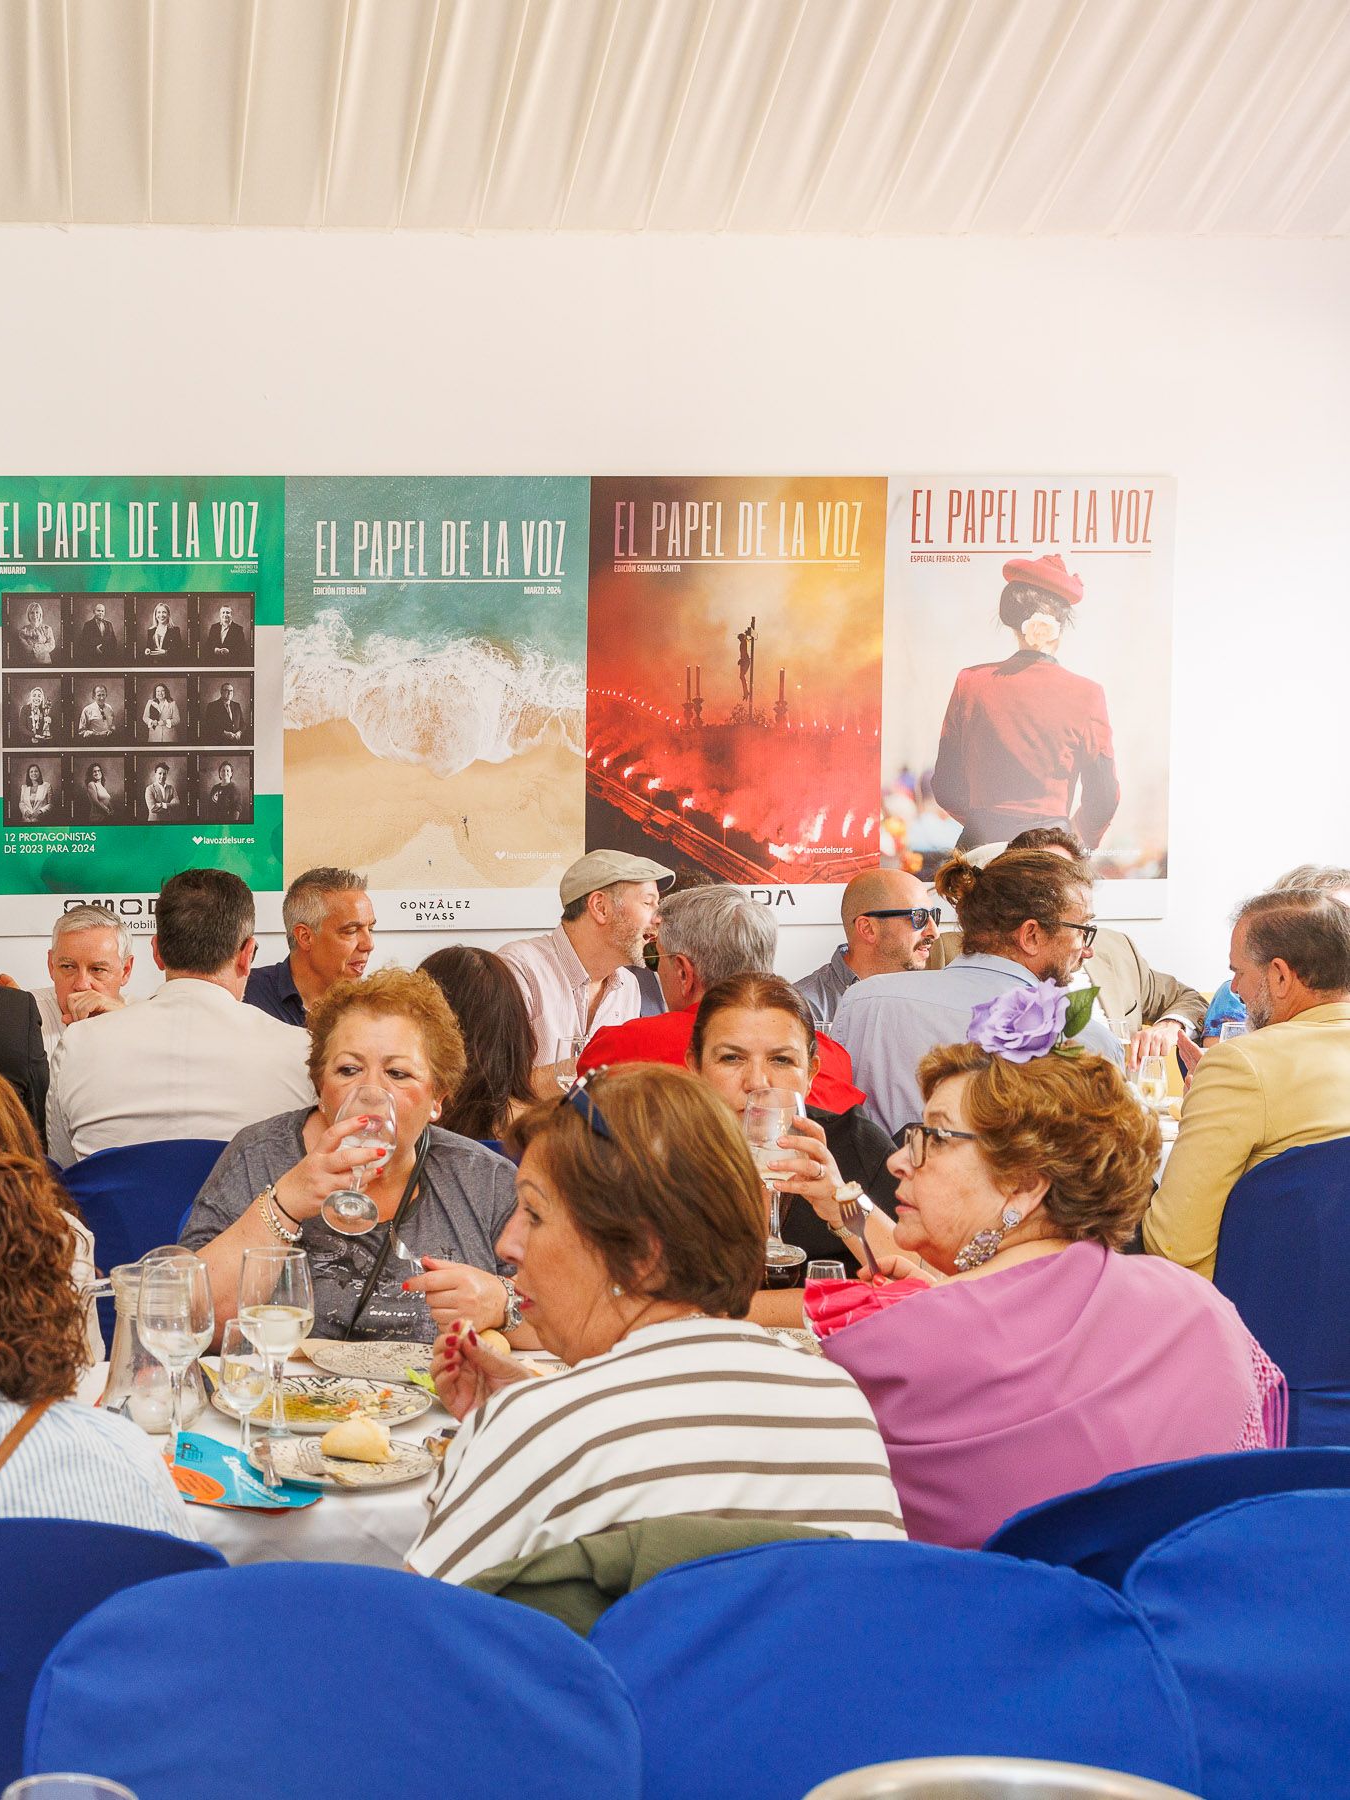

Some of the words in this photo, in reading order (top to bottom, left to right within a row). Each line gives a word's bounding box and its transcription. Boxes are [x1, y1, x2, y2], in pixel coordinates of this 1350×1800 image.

[911, 490, 934, 543] EL
[947, 490, 1019, 543] PAPEL
[1032, 490, 1062, 543] DE
[1072, 490, 1098, 543] LA
[1110, 490, 1154, 543] VOZ
[37, 502, 115, 558] PAPEL
[129, 502, 160, 558] DE
[172, 502, 200, 558] LA
[211, 502, 259, 558] VOZ
[614, 501, 638, 557] EL
[651, 501, 725, 557] PAPEL
[737, 501, 768, 557] DE
[778, 501, 805, 557] LA
[817, 501, 863, 557] VOZ
[316, 520, 340, 576] EL
[353, 520, 428, 576] PAPEL
[441, 520, 471, 576] DE
[482, 520, 509, 576] LA
[521, 520, 566, 576] VOZ
[910, 555, 935, 563] ESPECIAL
[936, 555, 956, 563] FERIAS
[956, 555, 970, 563] 2024
[0, 566, 26, 574] ANUARIO
[614, 562, 636, 573] EDICIÓN
[637, 564, 662, 573] SEMANA
[662, 564, 681, 572] SANTA
[313, 584, 335, 595] EDICIÓN
[336, 586, 346, 595] ITB
[346, 585, 366, 595] BERLÍN
[524, 586, 545, 594] MARZO
[546, 586, 562, 594] 2024
[4, 833, 16, 842] 12
[19, 831, 97, 842] PROTAGONISTAS
[203, 836, 255, 845] lavozdelsur.es
[4, 845, 17, 854] DE
[19, 845, 43, 854] 2023
[46, 845, 70, 854] PARA
[71, 845, 95, 853] 2024
[400, 899, 471, 909] GONZÁLEZ
[416, 913, 455, 921] BYASS
[125, 920, 157, 929] Mobili
